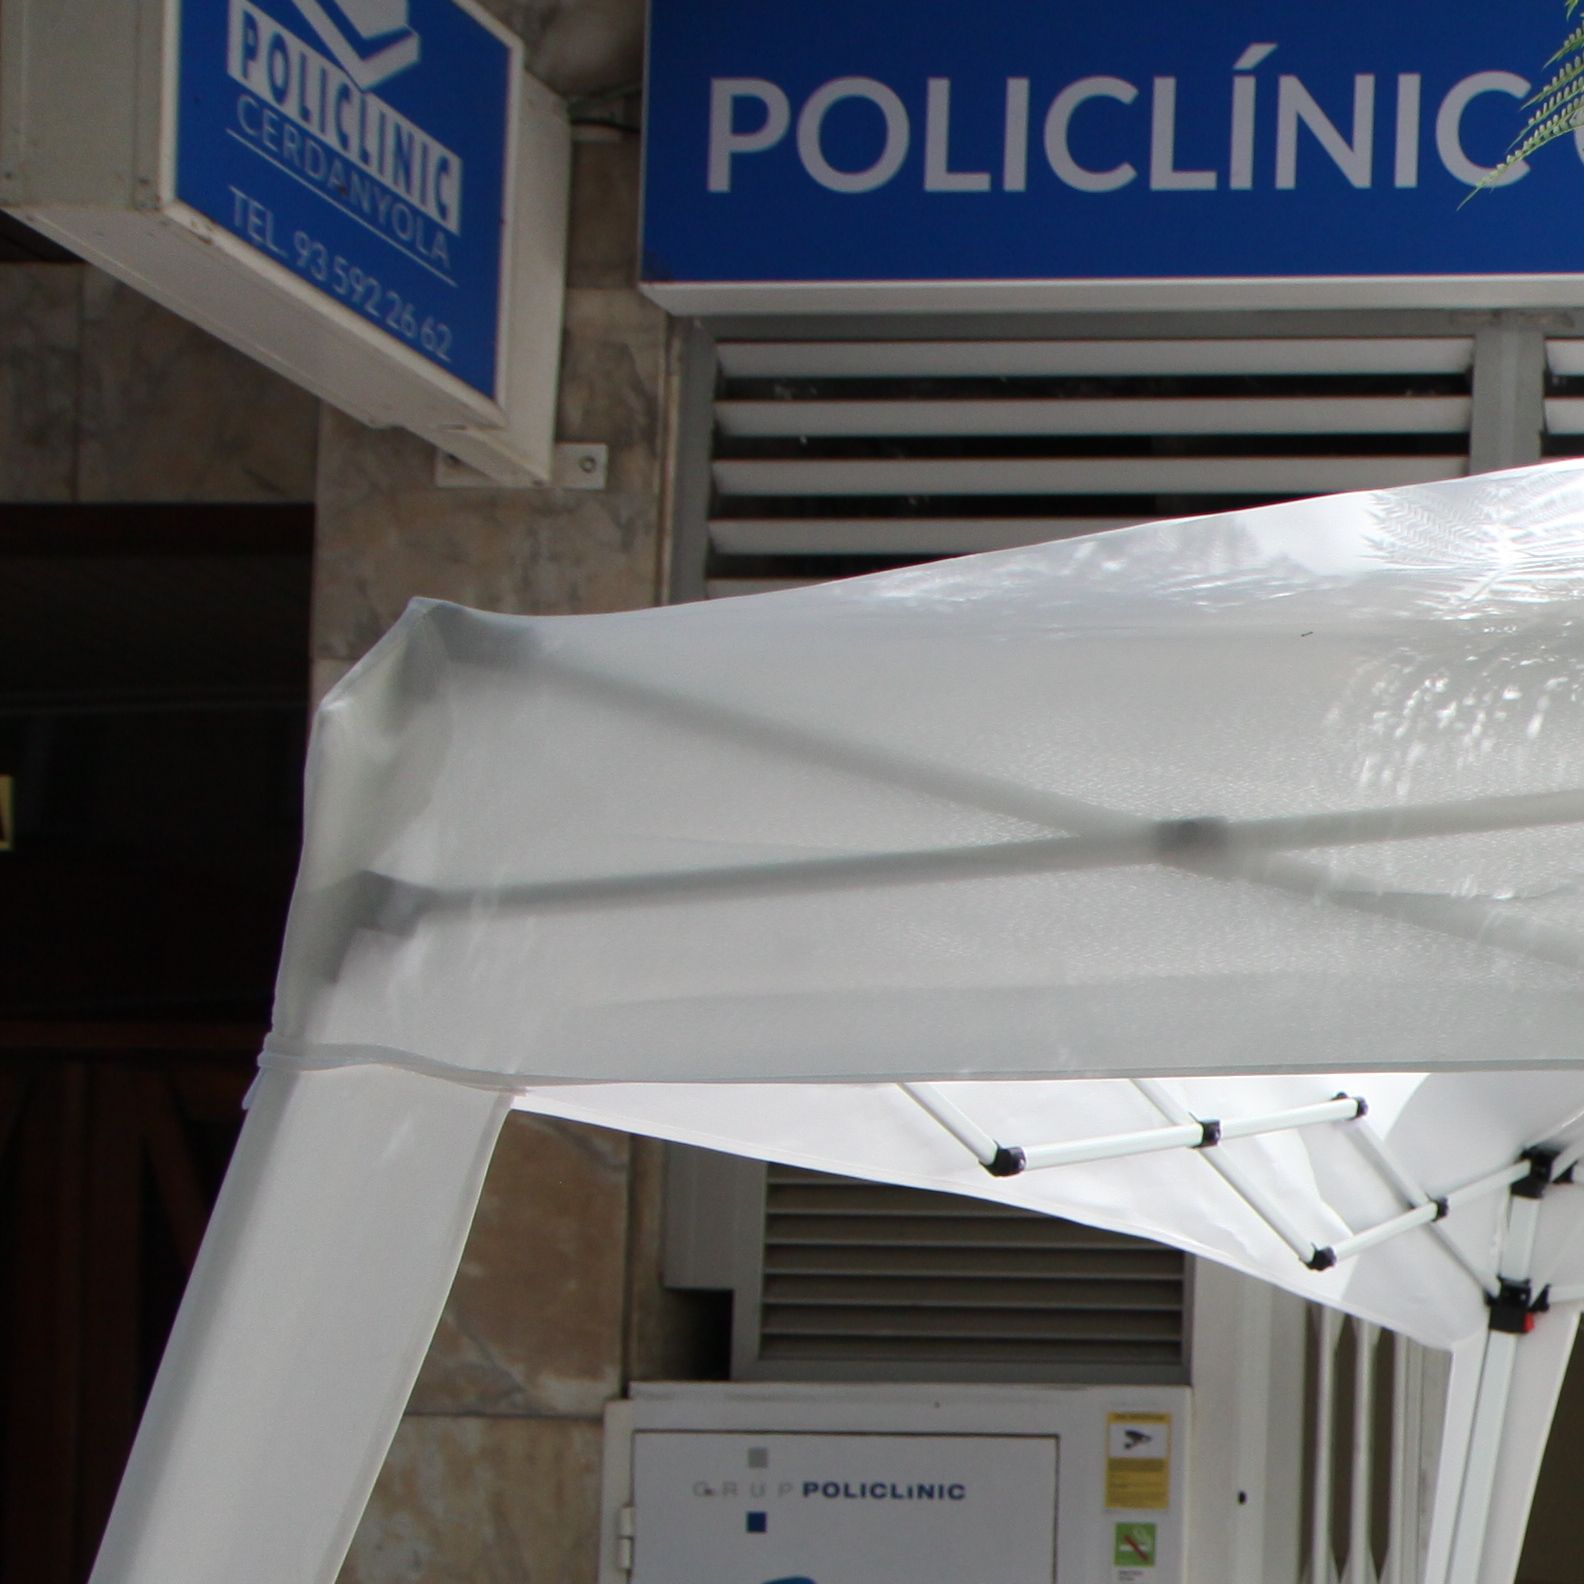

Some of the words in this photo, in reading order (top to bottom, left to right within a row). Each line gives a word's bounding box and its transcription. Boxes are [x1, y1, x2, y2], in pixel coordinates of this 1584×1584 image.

[236, 94, 452, 270] CERDANYOLA
[239, 4, 455, 222] POLICLINIC
[707, 43, 1531, 193] POLICLÍNIC
[294, 231, 330, 280] 93
[333, 257, 380, 312] 592
[385, 290, 418, 336] 26
[421, 320, 454, 362] 62
